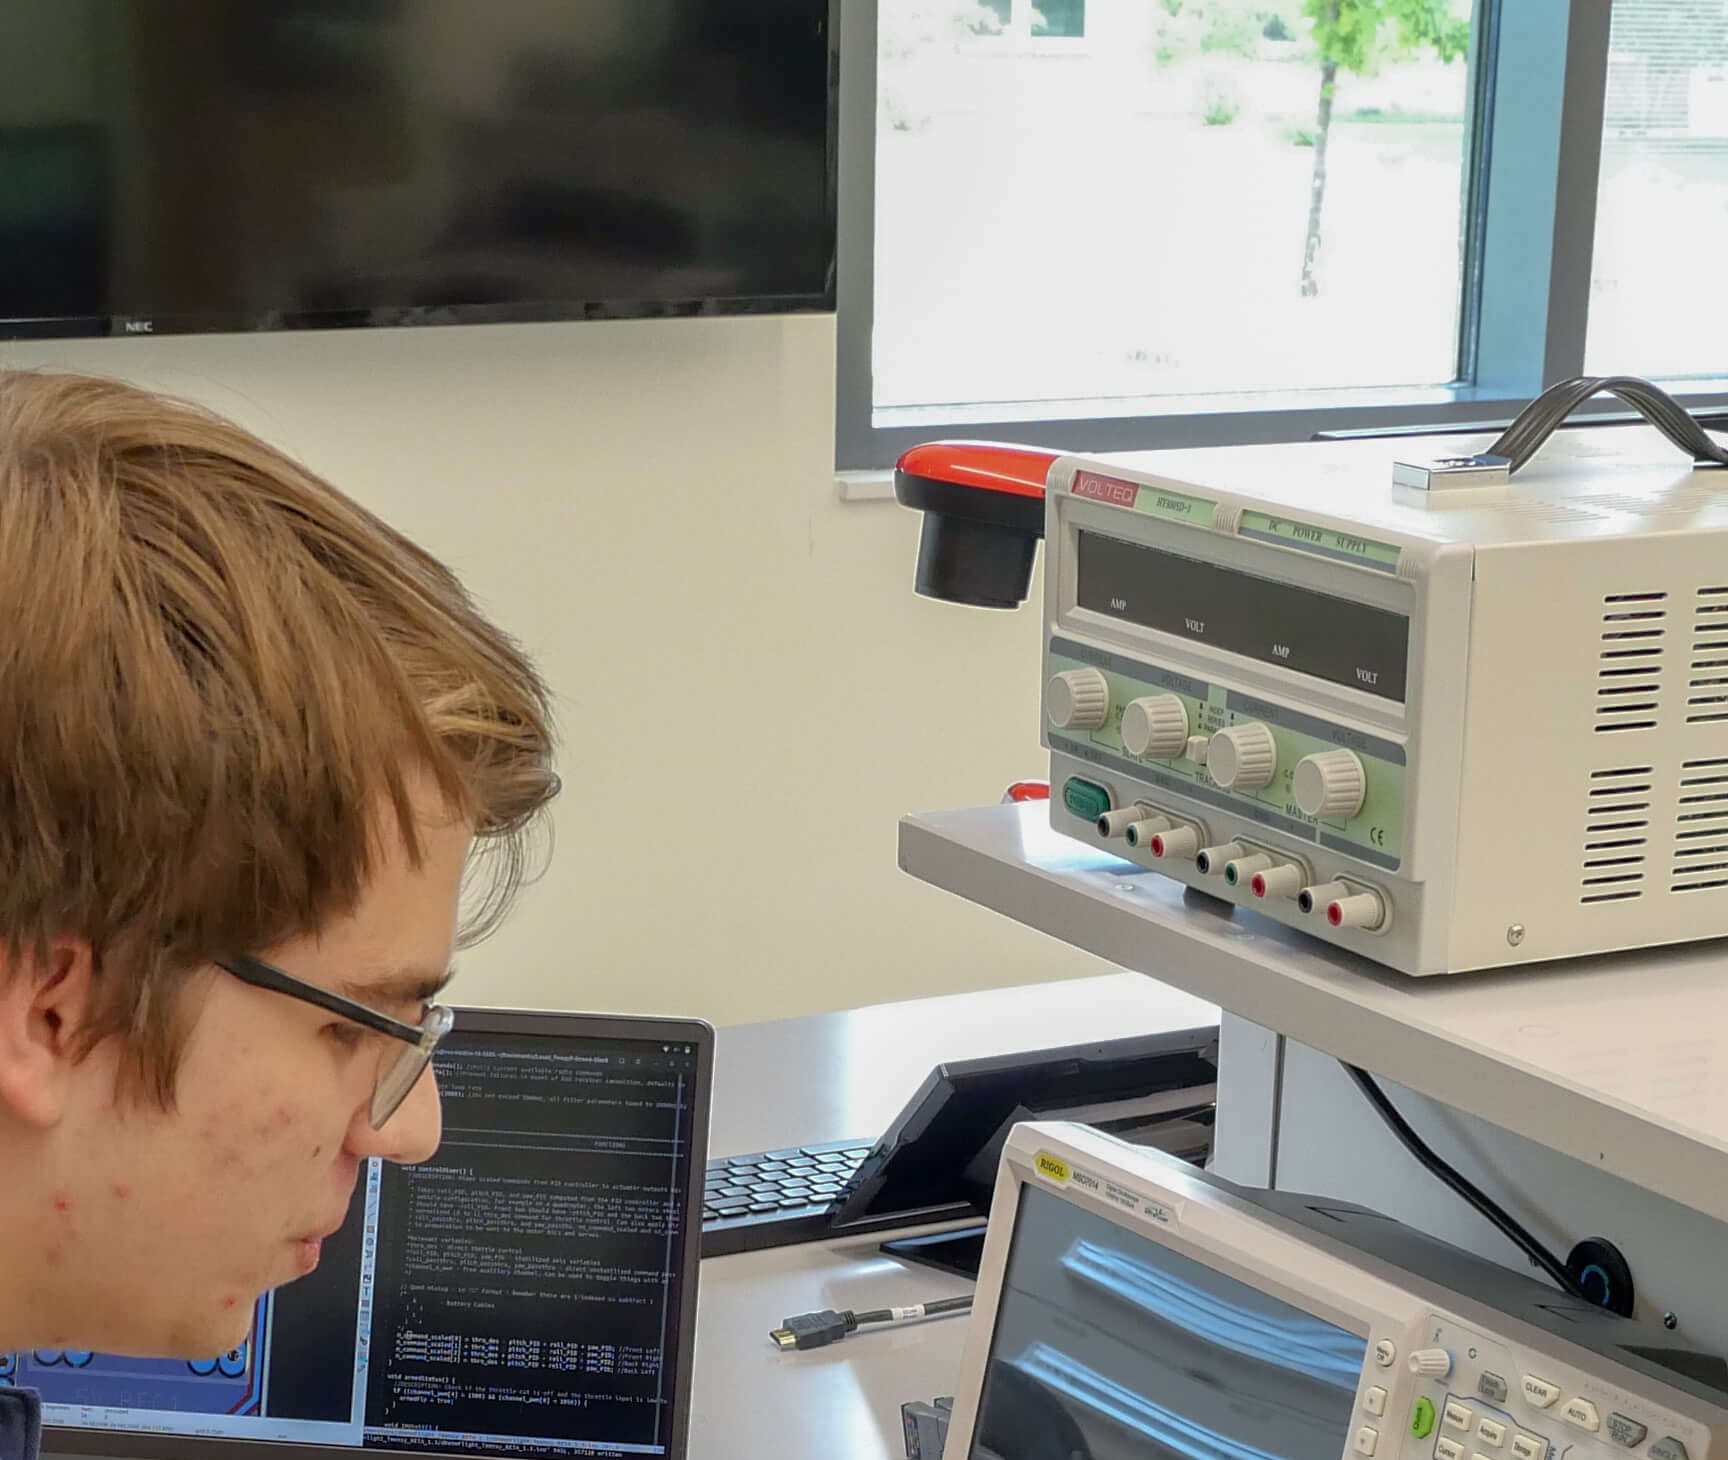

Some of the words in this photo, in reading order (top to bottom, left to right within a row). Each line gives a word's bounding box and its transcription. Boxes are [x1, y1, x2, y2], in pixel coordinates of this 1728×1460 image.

[126, 321, 152, 332] NEC
[1079, 476, 1133, 502] VOLTEQ
[1268, 519, 1280, 532] DC
[1292, 525, 1322, 542] POWER
[1335, 536, 1368, 554] SUPPLY
[1110, 597, 1127, 611] AMP
[1184, 617, 1206, 633] VOLT
[1271, 643, 1290, 659] AMP
[1355, 666, 1379, 685] VOLT
[1040, 1158, 1065, 1178] RIGOL
[1525, 1382, 1548, 1398] CLEAR
[1567, 1407, 1587, 1423] AUTO
